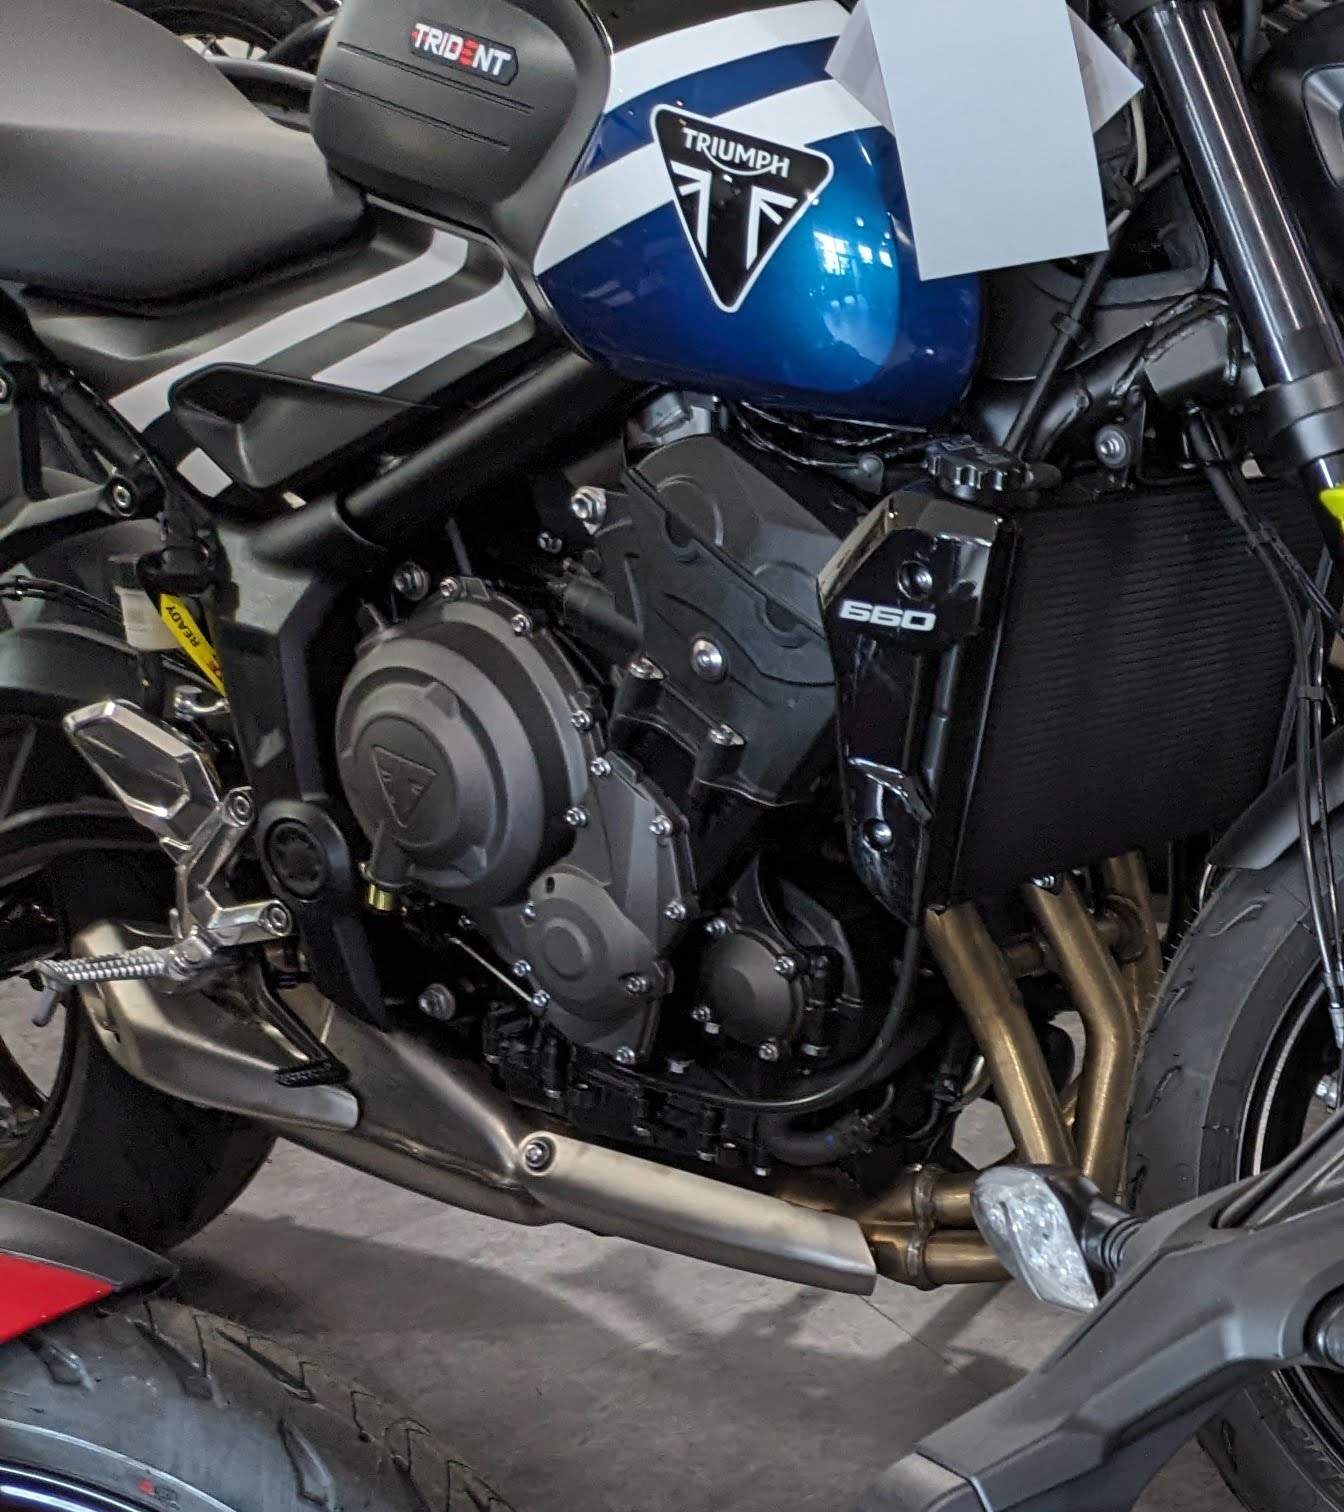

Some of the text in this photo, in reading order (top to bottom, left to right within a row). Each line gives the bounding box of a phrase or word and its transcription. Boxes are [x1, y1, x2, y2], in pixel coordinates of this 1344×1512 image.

[412, 22, 512, 76] TRIDENT
[682, 127, 791, 179] TRIUMPH
[165, 605, 201, 648] READY
[839, 599, 937, 632] 660
